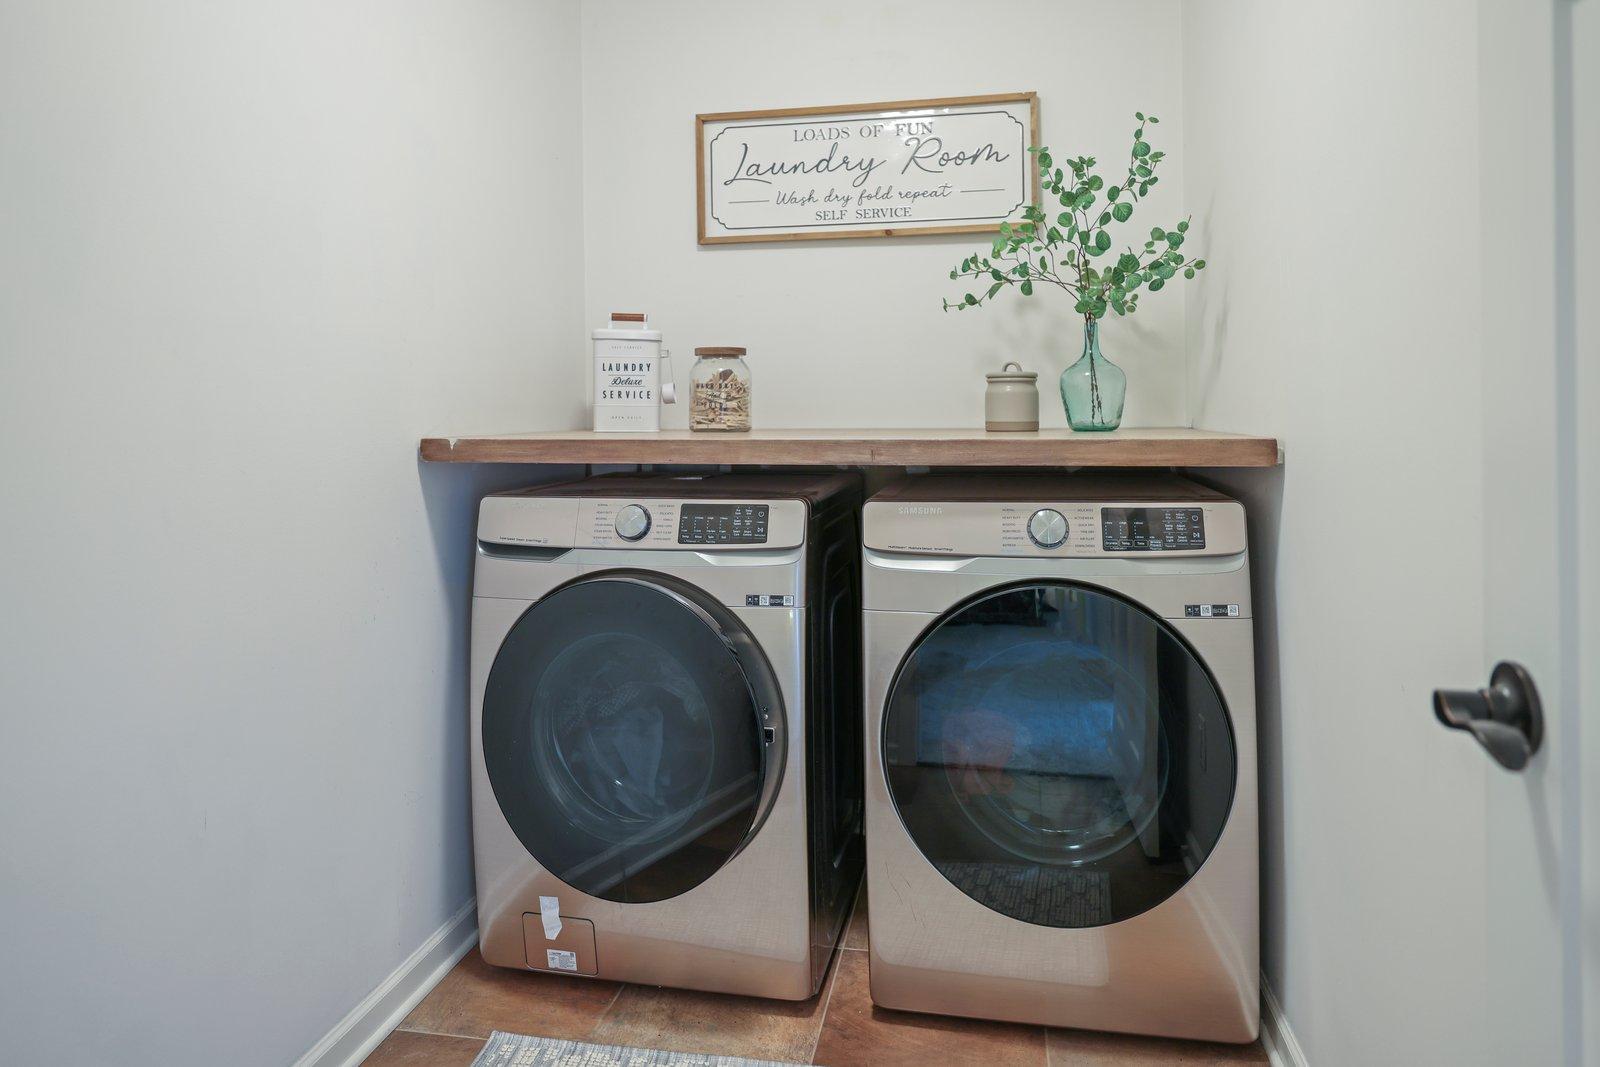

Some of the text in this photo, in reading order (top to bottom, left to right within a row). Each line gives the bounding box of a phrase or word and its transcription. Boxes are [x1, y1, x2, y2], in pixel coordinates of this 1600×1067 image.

[794, 121, 934, 142] LOADS OF FUN
[723, 137, 1010, 188] Laundry Room
[776, 183, 952, 207] Wash dry fold repeat
[815, 207, 912, 221] SELF SERVICE
[602, 362, 652, 372] LAUNDRY
[611, 376, 643, 386] Deluxe
[602, 390, 652, 399] SERVICE
[897, 505, 943, 514] SAMSUNG
